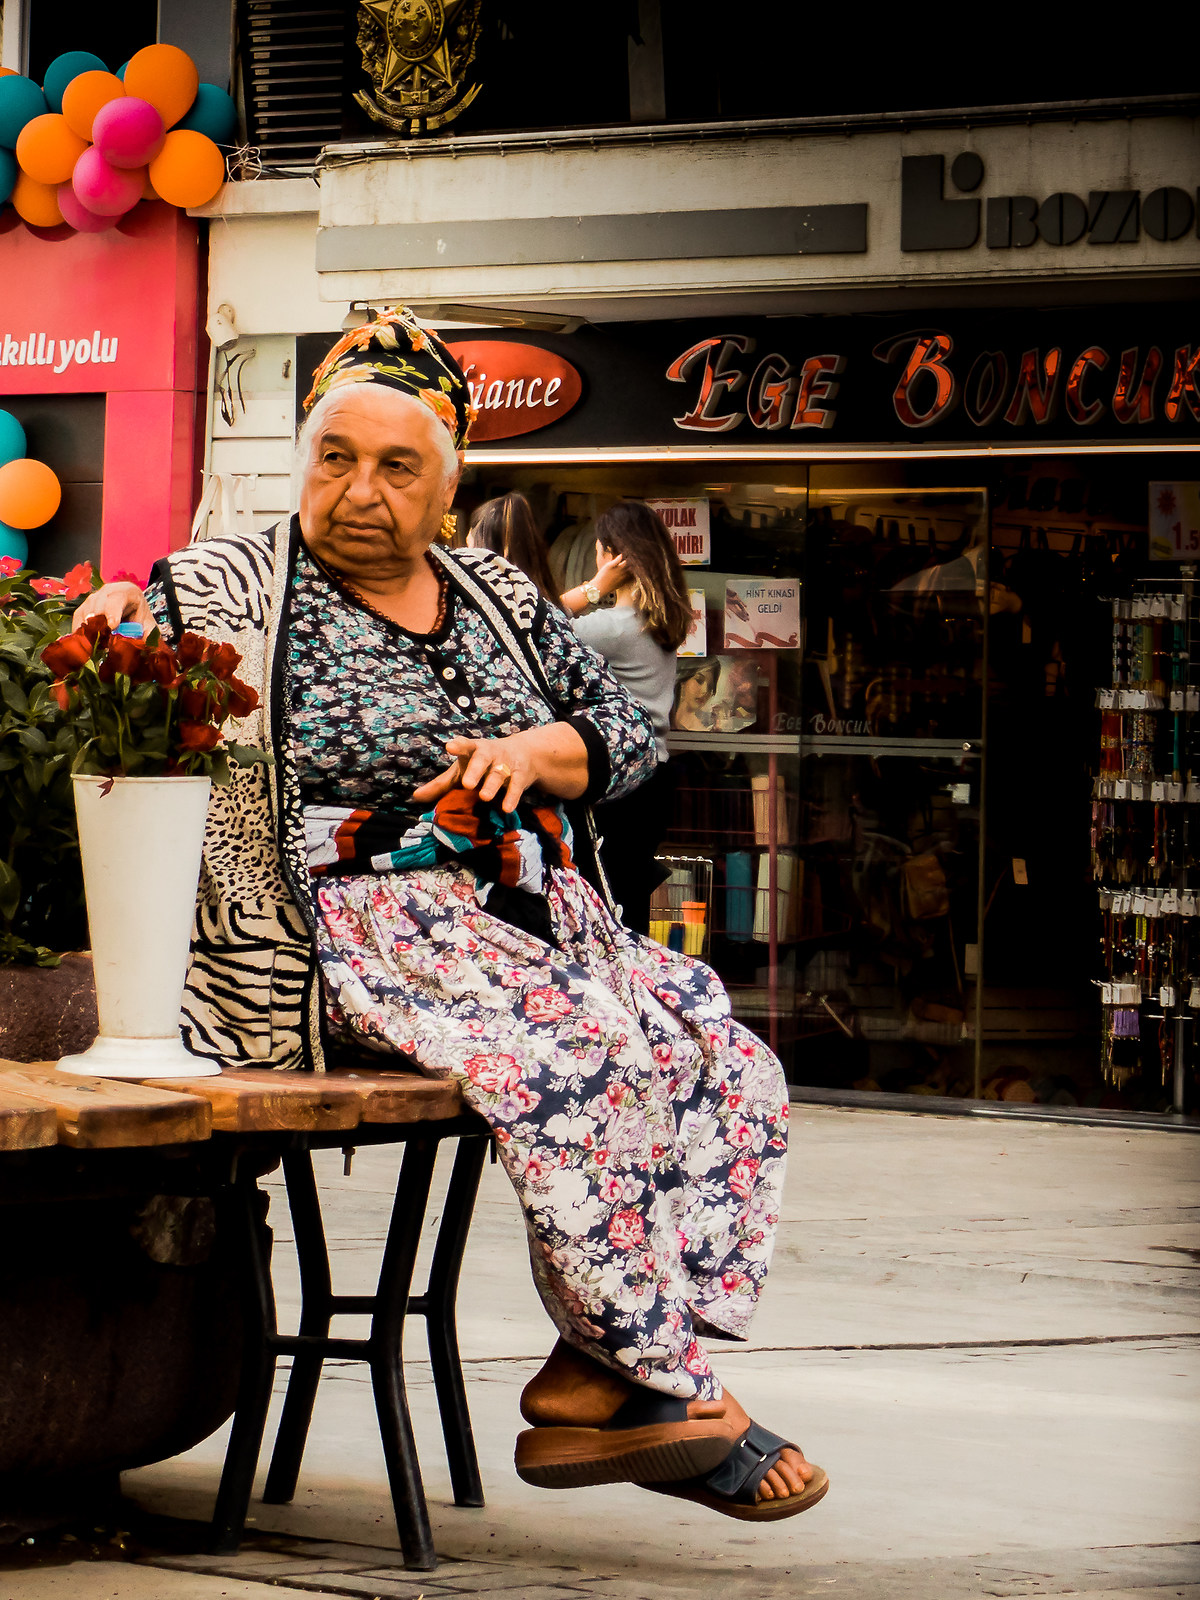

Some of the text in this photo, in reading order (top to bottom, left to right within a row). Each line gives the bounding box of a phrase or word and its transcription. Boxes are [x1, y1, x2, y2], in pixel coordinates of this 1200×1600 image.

[53, 330, 119, 374] yolu
[666, 334, 844, 432] EGE
[672, 532, 704, 555] İNİR!
[1172, 521, 1200, 550] 1.5
[757, 602, 782, 614] GELDİ
